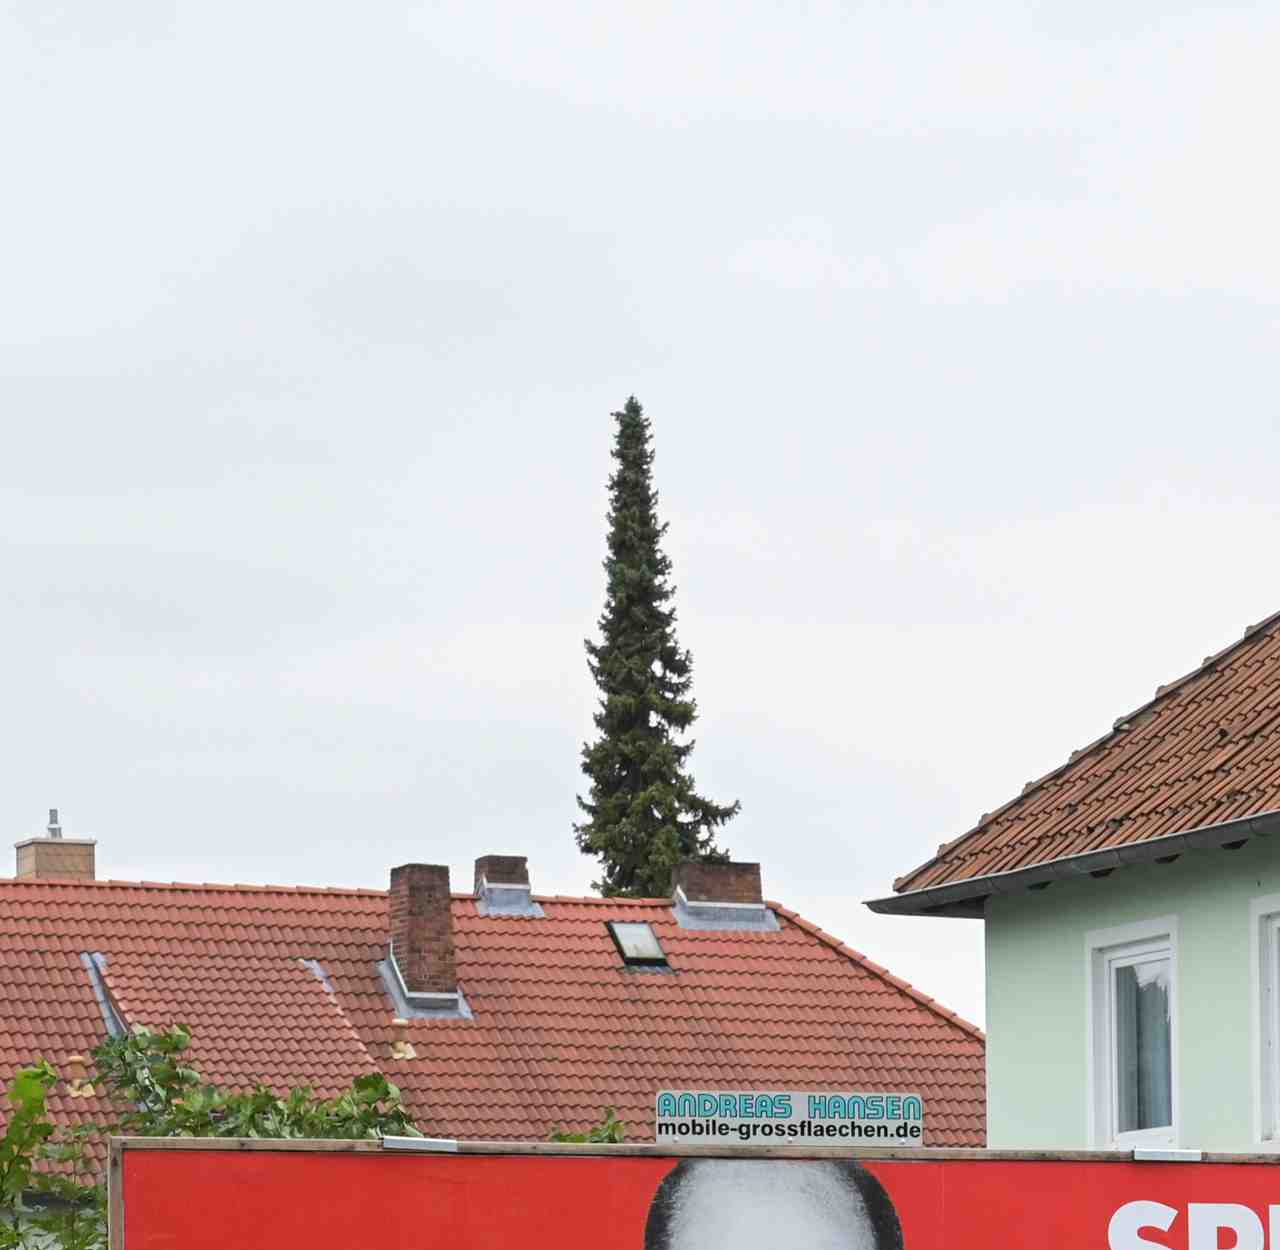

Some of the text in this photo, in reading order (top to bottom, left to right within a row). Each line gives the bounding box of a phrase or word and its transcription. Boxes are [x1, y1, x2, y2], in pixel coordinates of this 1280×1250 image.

[657, 1093, 922, 1120] ANDREAS HANSEN
[657, 1119, 921, 1141] mobile-grossflaechen.de
